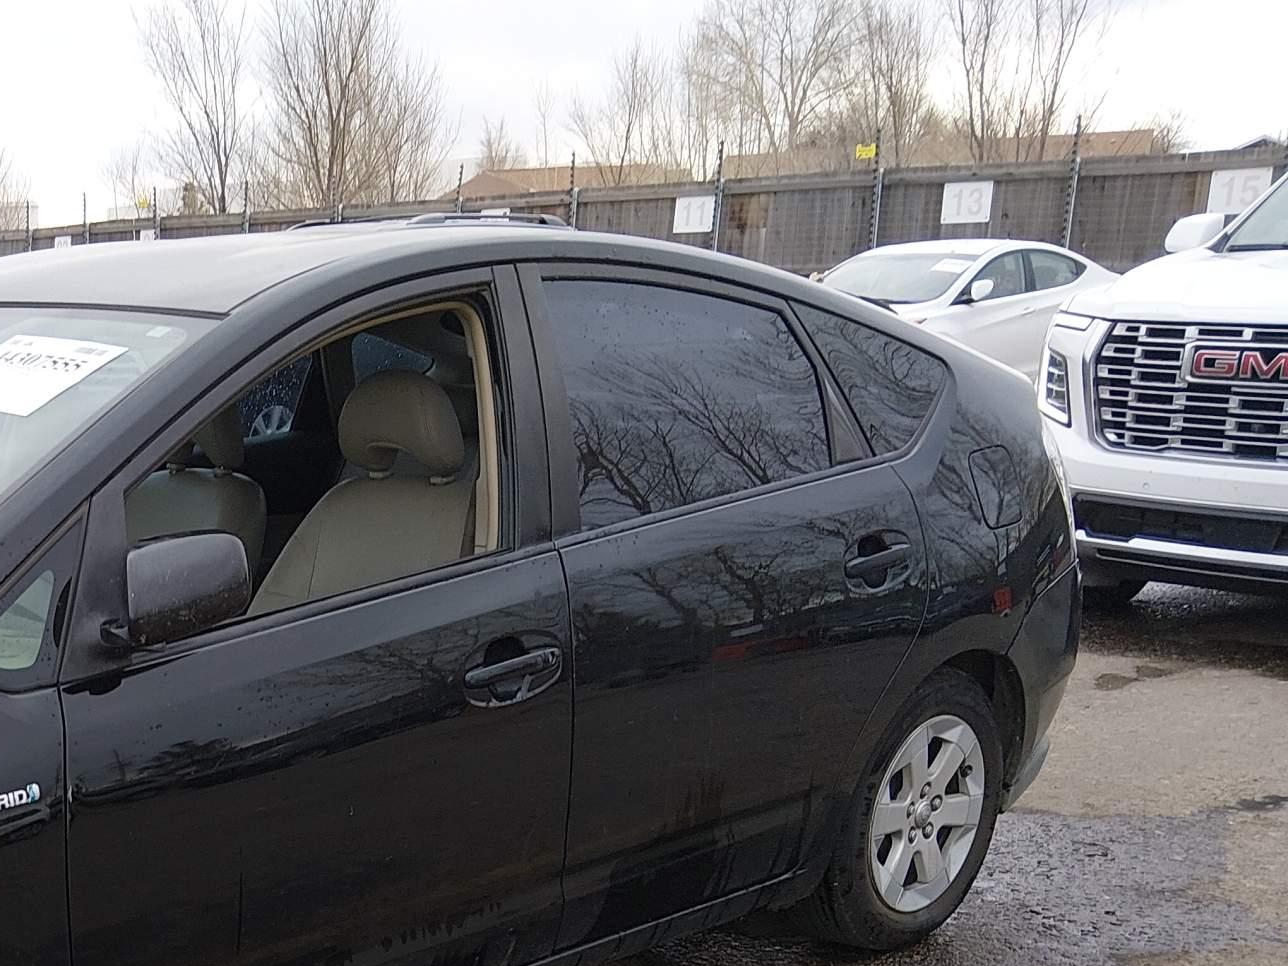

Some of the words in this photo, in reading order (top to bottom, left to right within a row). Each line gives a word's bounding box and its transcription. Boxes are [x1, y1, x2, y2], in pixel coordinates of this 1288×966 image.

[952, 188, 983, 216] 13
[1221, 174, 1261, 208] 15
[682, 200, 705, 226] 11
